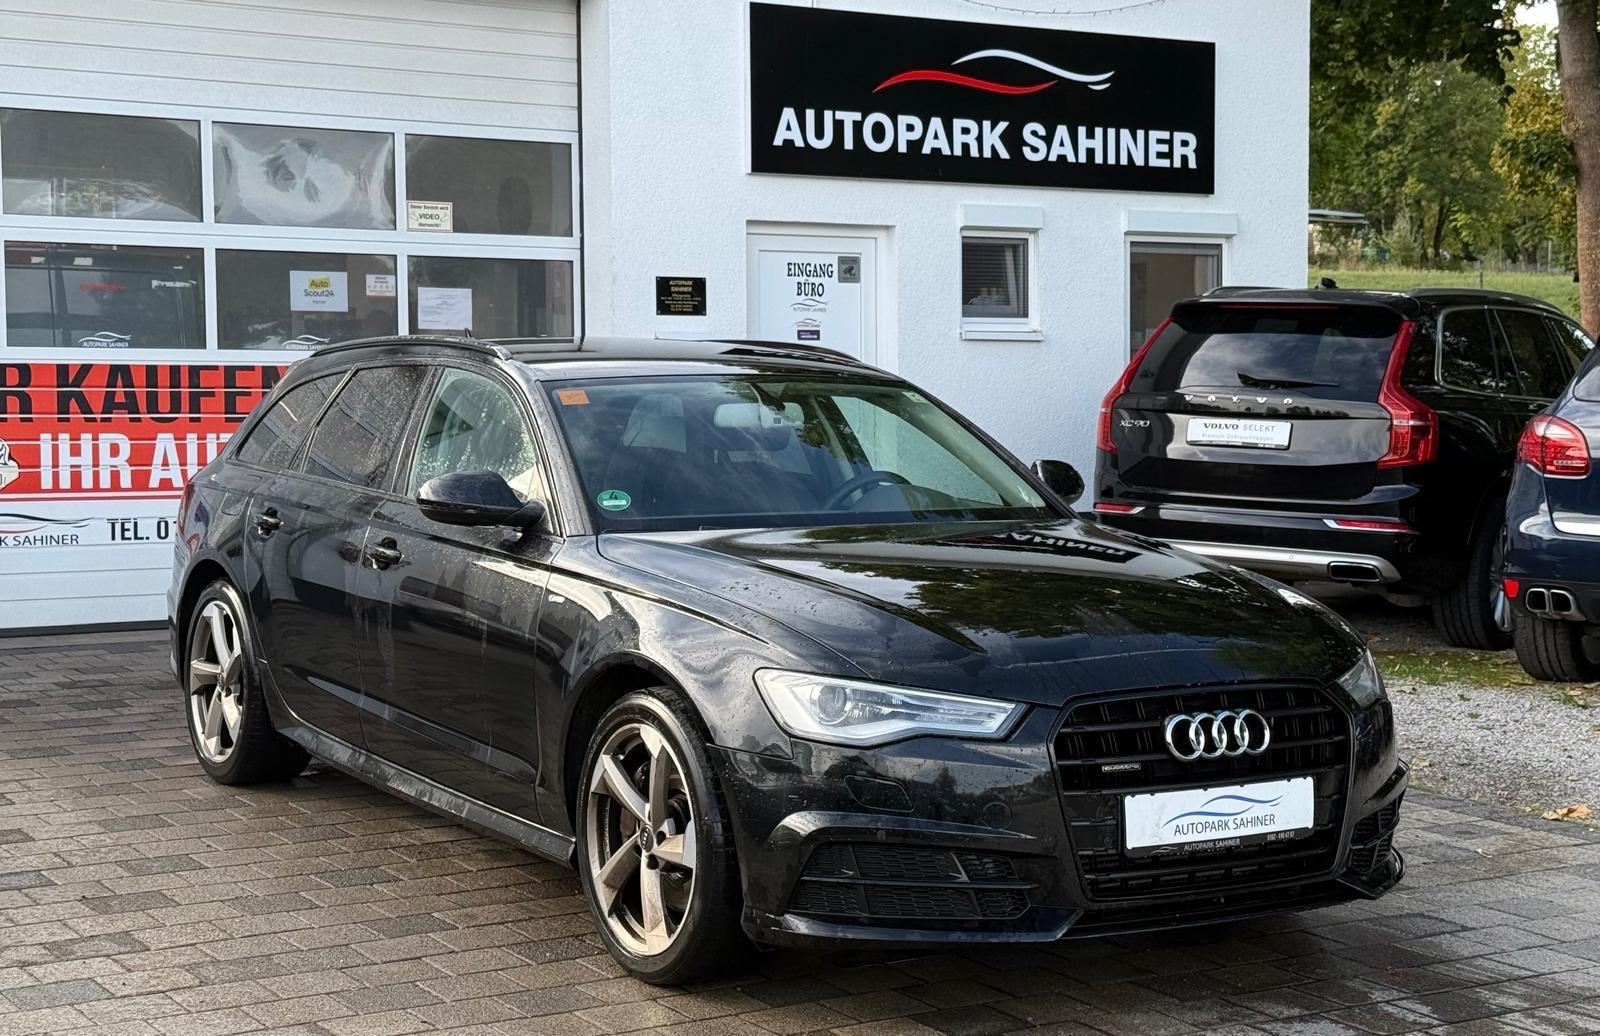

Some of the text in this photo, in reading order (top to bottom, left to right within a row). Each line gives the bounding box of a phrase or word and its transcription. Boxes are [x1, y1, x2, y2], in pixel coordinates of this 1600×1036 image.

[773, 106, 1198, 169] AUTOPARK SAHINER
[786, 262, 834, 278] EINGANG
[310, 279, 329, 288] Auto
[796, 279, 825, 297] BÜRO
[303, 289, 335, 297] Scout24
[1203, 422, 1277, 433] VOLVO SELEKT
[40, 433, 132, 490] IHR
[107, 518, 150, 541] TEL.
[12, 534, 80, 547] SAHINER
[1173, 813, 1276, 837] AUTOPARK SAHINER
[1183, 838, 1241, 851] AUTOPARK SAHINER
